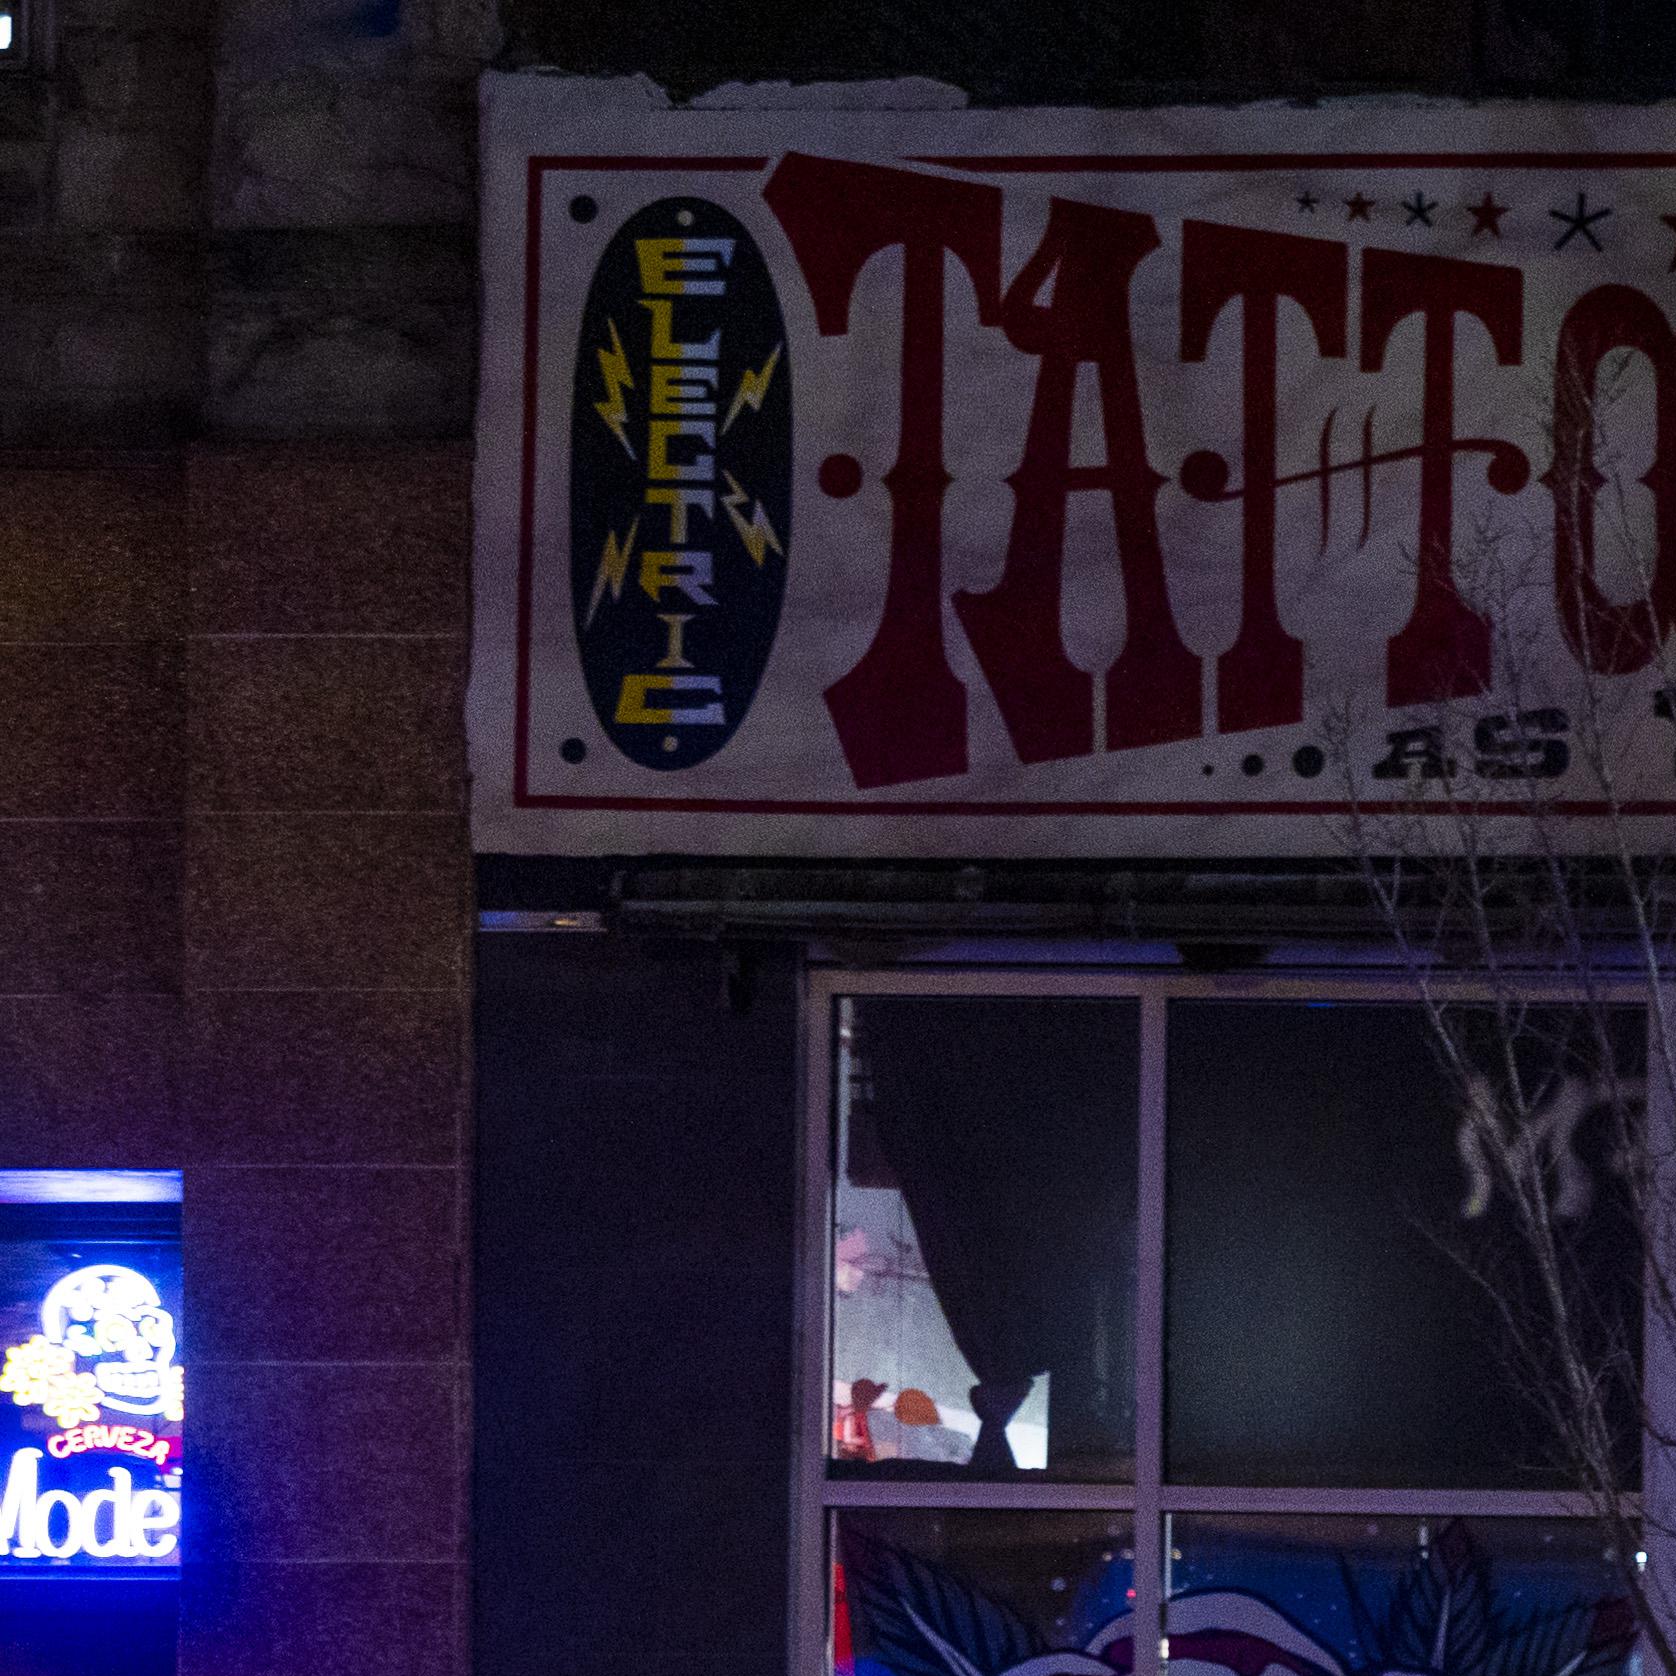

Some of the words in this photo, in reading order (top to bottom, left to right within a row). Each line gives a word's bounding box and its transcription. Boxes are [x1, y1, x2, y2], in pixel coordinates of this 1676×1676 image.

[614, 237, 735, 728] ELECTRIC
[1373, 706, 1570, 778] AS
[47, 1424, 170, 1466] CERVEZA
